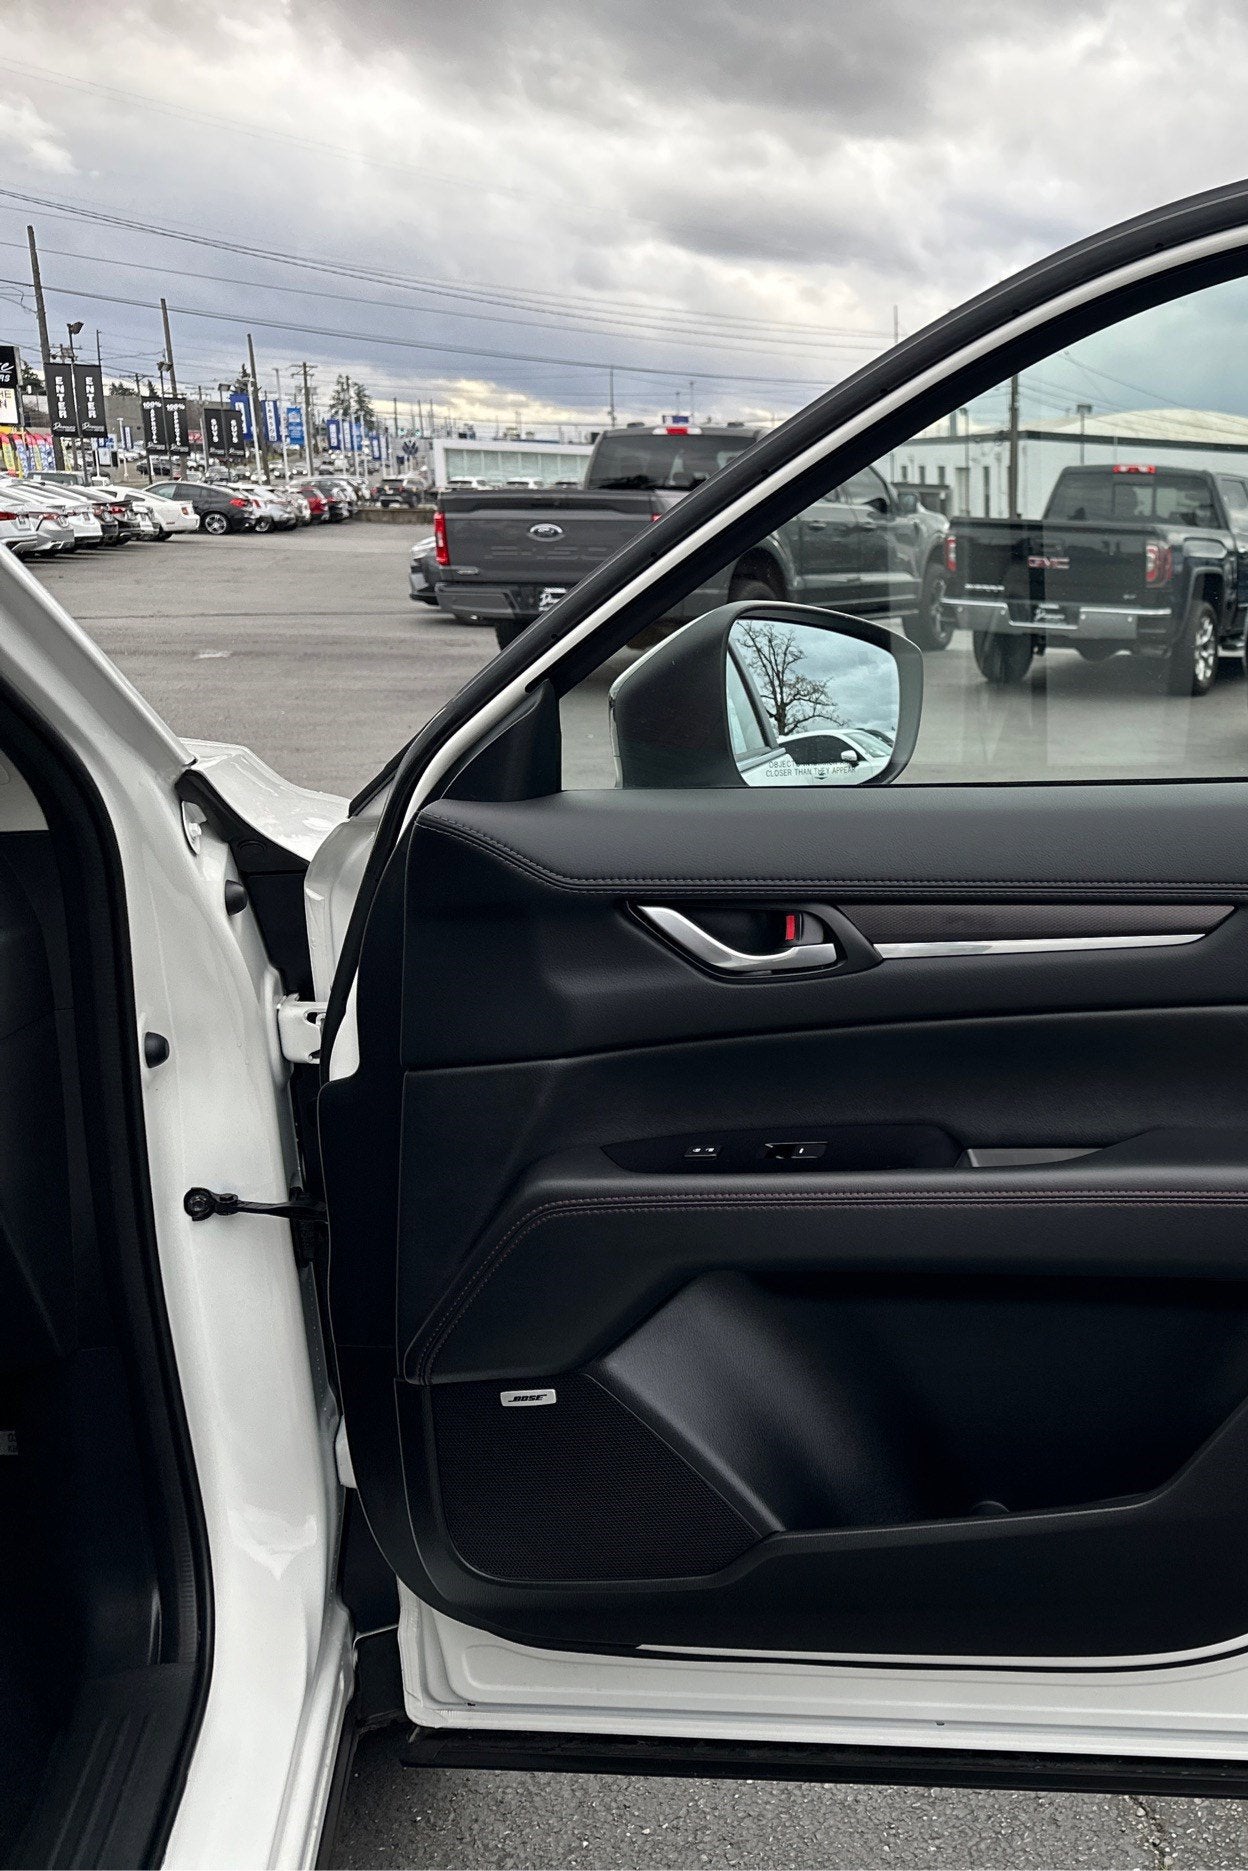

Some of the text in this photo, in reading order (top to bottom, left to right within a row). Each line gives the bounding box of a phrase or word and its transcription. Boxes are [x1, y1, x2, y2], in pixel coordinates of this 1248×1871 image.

[55, 376, 67, 419] ENTER
[85, 376, 97, 419] ENTER
[143, 401, 162, 409] 100%
[166, 403, 185, 411] 100%
[766, 769, 792, 778] CLOSER
[795, 767, 812, 776] THAN
[814, 767, 830, 775] THEY
[832, 765, 856, 775] APPEAR
[508, 1394, 547, 1403] BOSE
